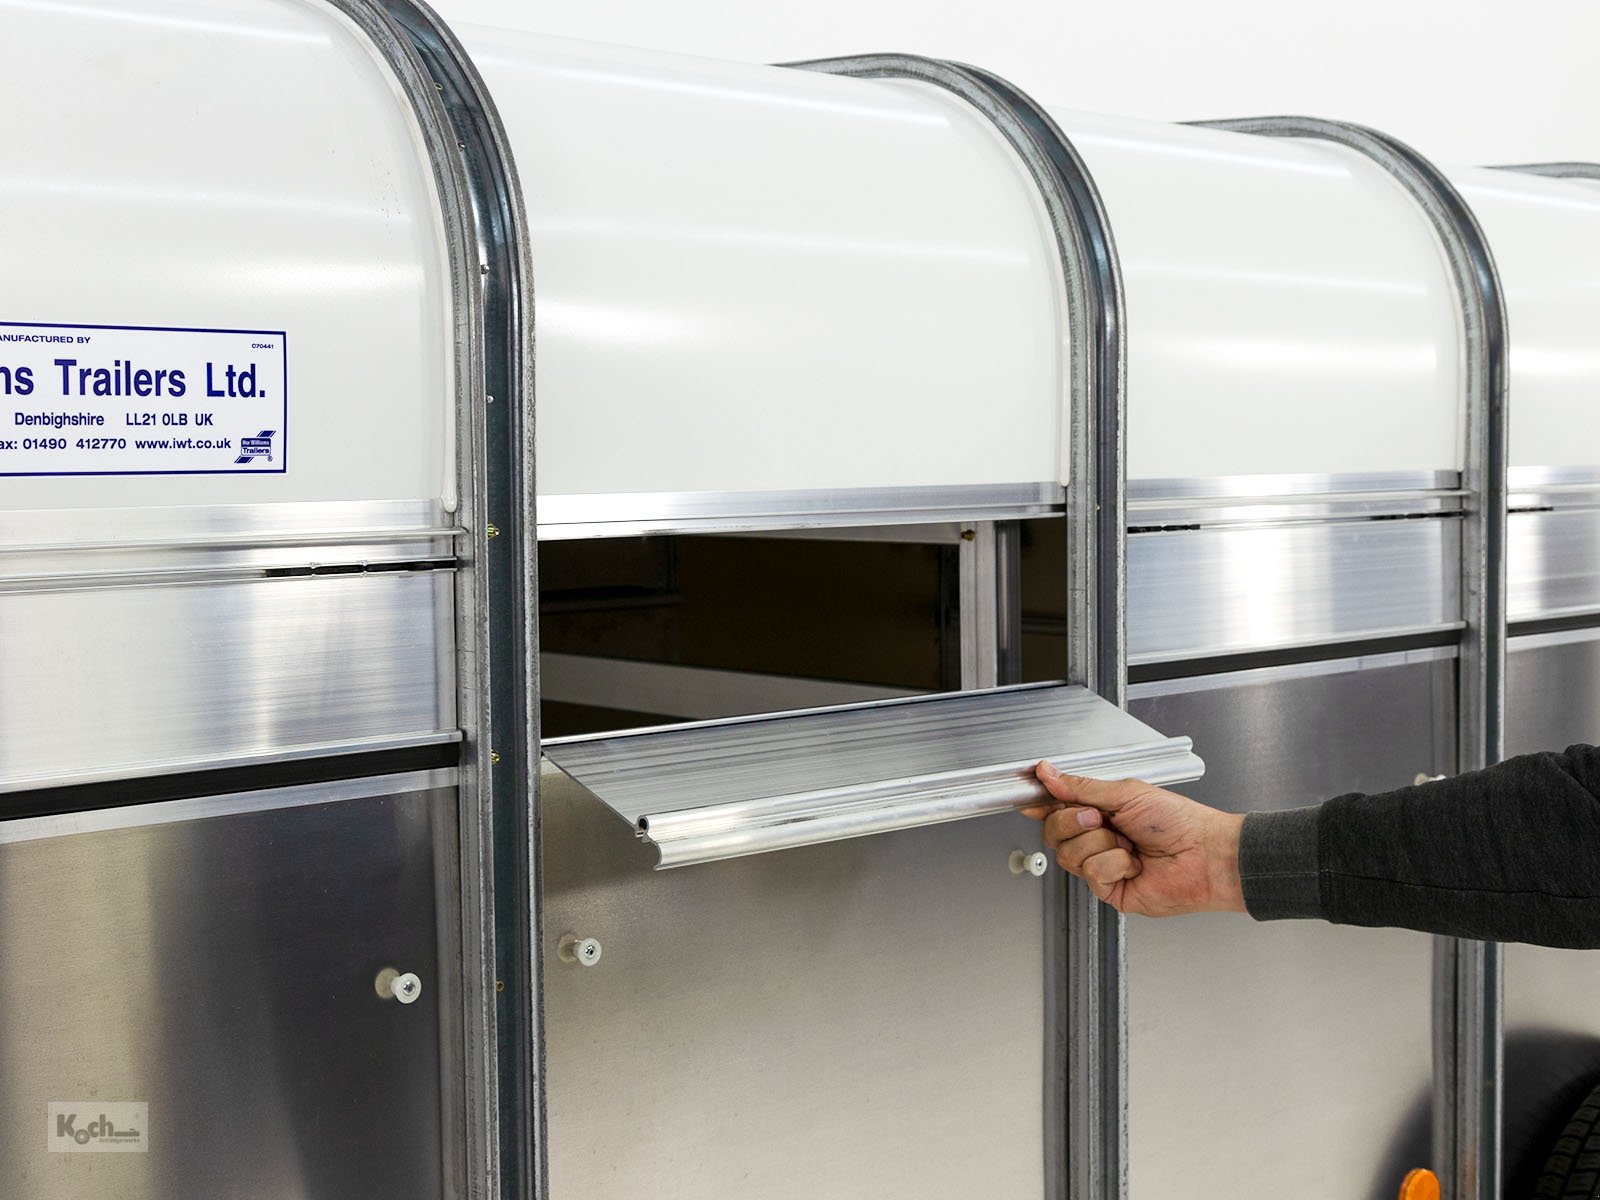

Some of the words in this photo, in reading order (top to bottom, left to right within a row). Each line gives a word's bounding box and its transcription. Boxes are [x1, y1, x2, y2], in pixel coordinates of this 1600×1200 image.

[77, 336, 91, 344] BY
[54, 359, 187, 397] Trailers
[206, 362, 266, 398] Ltd.
[14, 412, 105, 429] Denbighshire
[126, 413, 157, 426] LL21
[195, 414, 214, 426] UK
[22, 438, 67, 450] 01490
[75, 438, 127, 450] 412770
[135, 437, 232, 449] www.iwt.co.uk
